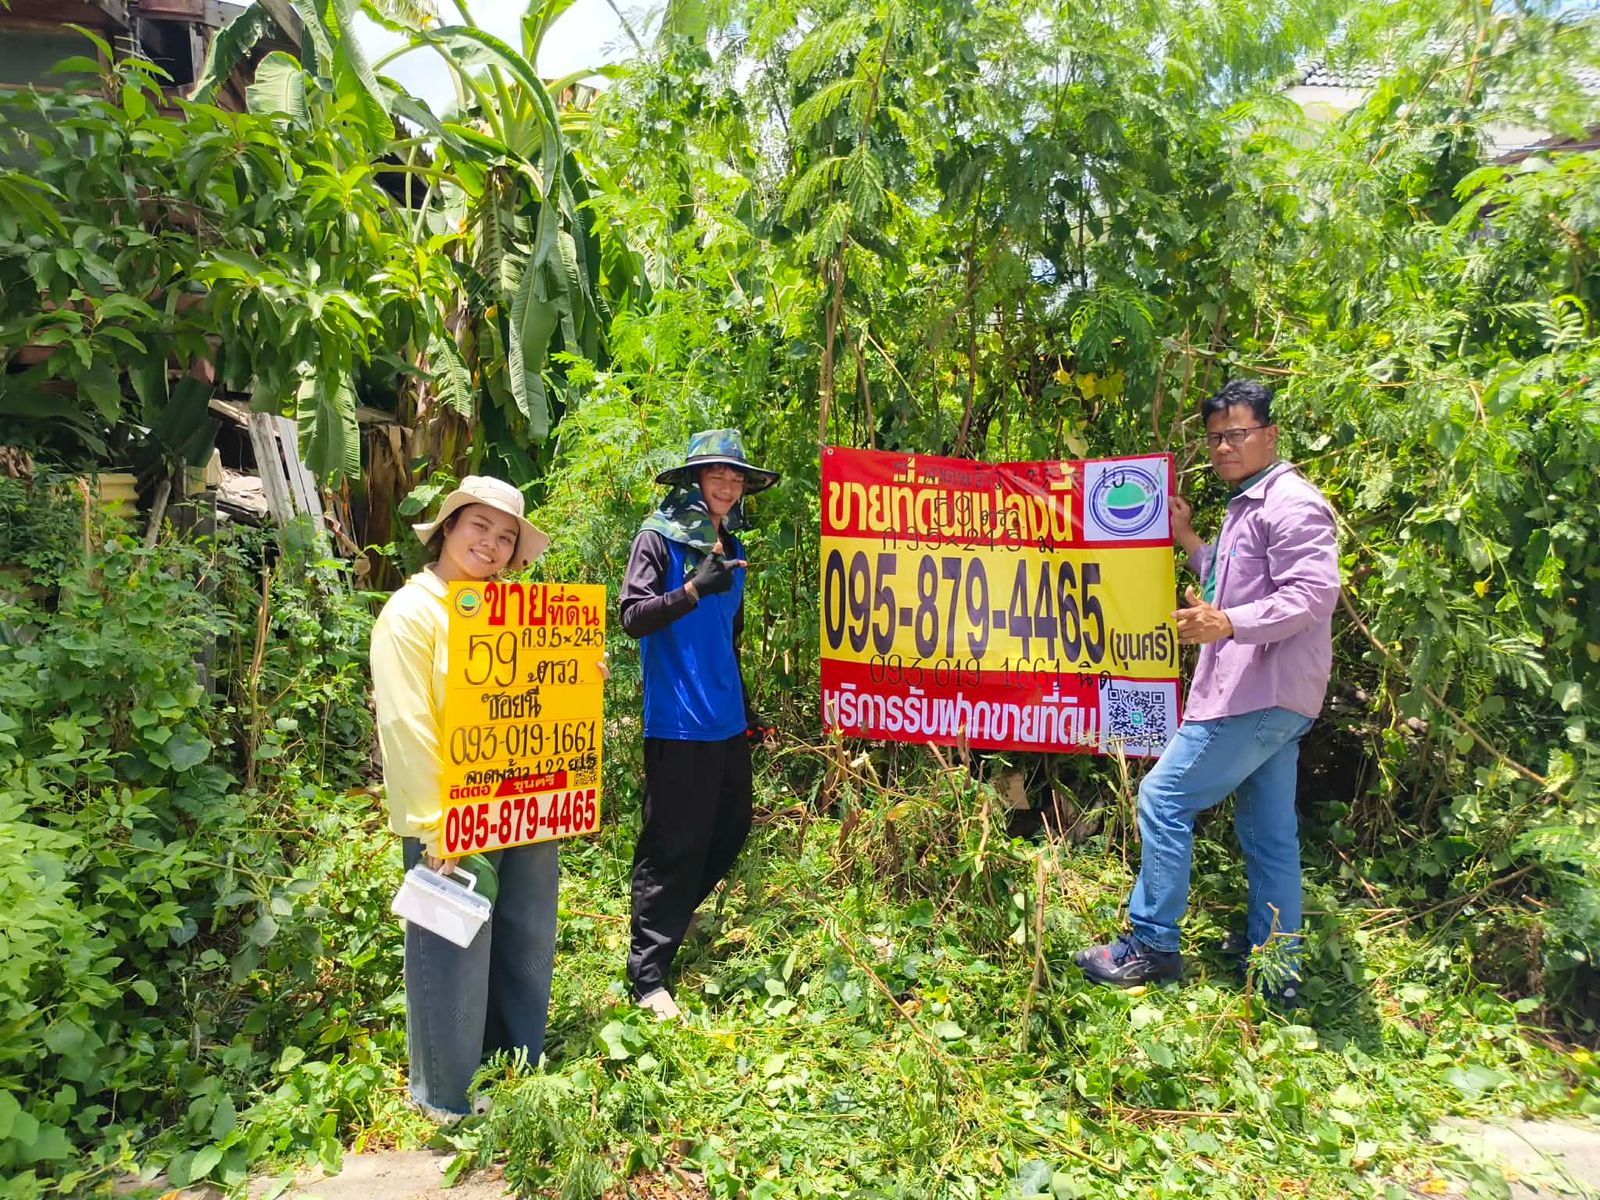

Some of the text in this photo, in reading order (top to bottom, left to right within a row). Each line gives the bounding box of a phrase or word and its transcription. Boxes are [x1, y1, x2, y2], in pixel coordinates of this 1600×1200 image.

[828, 457, 1074, 543] ขายที่ดินแปลงนี้
[934, 495, 972, 527] 59
[484, 581, 600, 628] ขาย ที่ดิน
[824, 548, 1175, 671] 095-879-4465 (ขุนศรี)
[464, 631, 519, 687] 59
[824, 682, 1096, 746] บริการรับฝากขายที่ดิน
[450, 720, 596, 766] 093-019-1661
[449, 782, 491, 800] ติดต่อ
[445, 789, 597, 854] 095-879-4465
